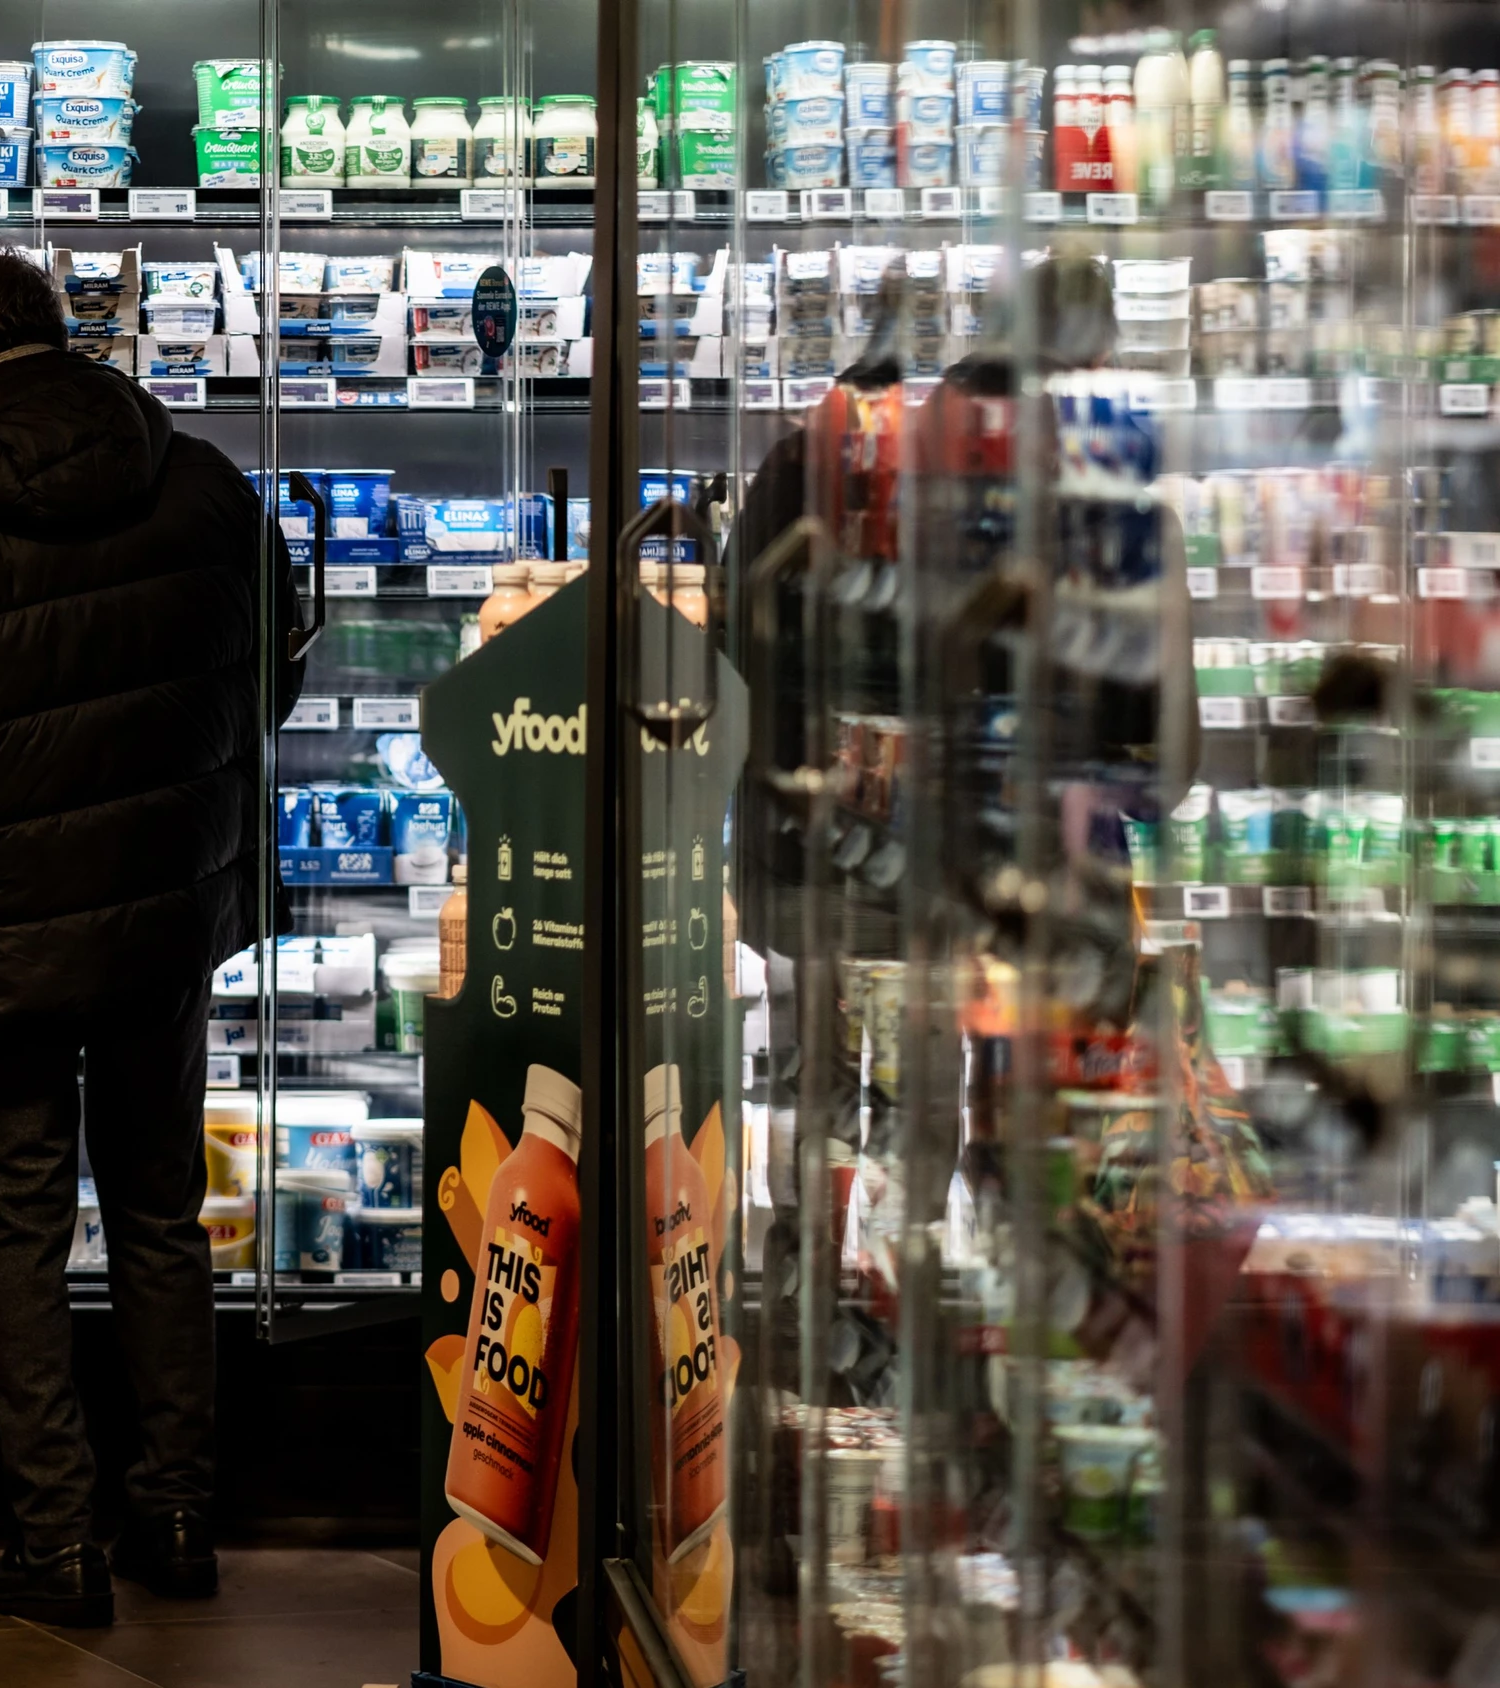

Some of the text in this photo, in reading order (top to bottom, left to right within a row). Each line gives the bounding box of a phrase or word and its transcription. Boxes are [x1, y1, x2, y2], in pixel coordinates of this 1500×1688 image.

[52, 55, 83, 65] Exquisa
[44, 66, 95, 77] Quark Creme
[66, 103, 99, 113] Exquisa
[55, 114, 108, 125] Quark Creme
[204, 141, 258, 155] CremQuark
[72, 151, 105, 161] Exquisa
[61, 162, 114, 174] Quark Creme
[331, 488, 360, 497] ELINAS
[443, 511, 490, 522] ELINAS
[404, 548, 431, 556] ELINAS
[492, 697, 587, 756] yfood
[409, 821, 446, 833] Joghurt
[533, 851, 568, 866] Hält dich
[533, 865, 572, 880] lange satt
[533, 919, 543, 931] 26
[544, 920, 579, 935] Vitamine
[533, 934, 584, 950] Mineralstoffe
[224, 970, 243, 988] ja!
[533, 987, 565, 1002] Reich an
[533, 1002, 561, 1016] Protein
[225, 1026, 245, 1046] ja!
[510, 1201, 551, 1238] yfood
[85, 1222, 100, 1243] ja
[487, 1243, 541, 1303] THIS
[480, 1288, 504, 1331] IS
[473, 1334, 548, 1410] FOOD
[463, 1421, 534, 1473] apple cinnamon
[473, 1448, 514, 1480] geschmack
